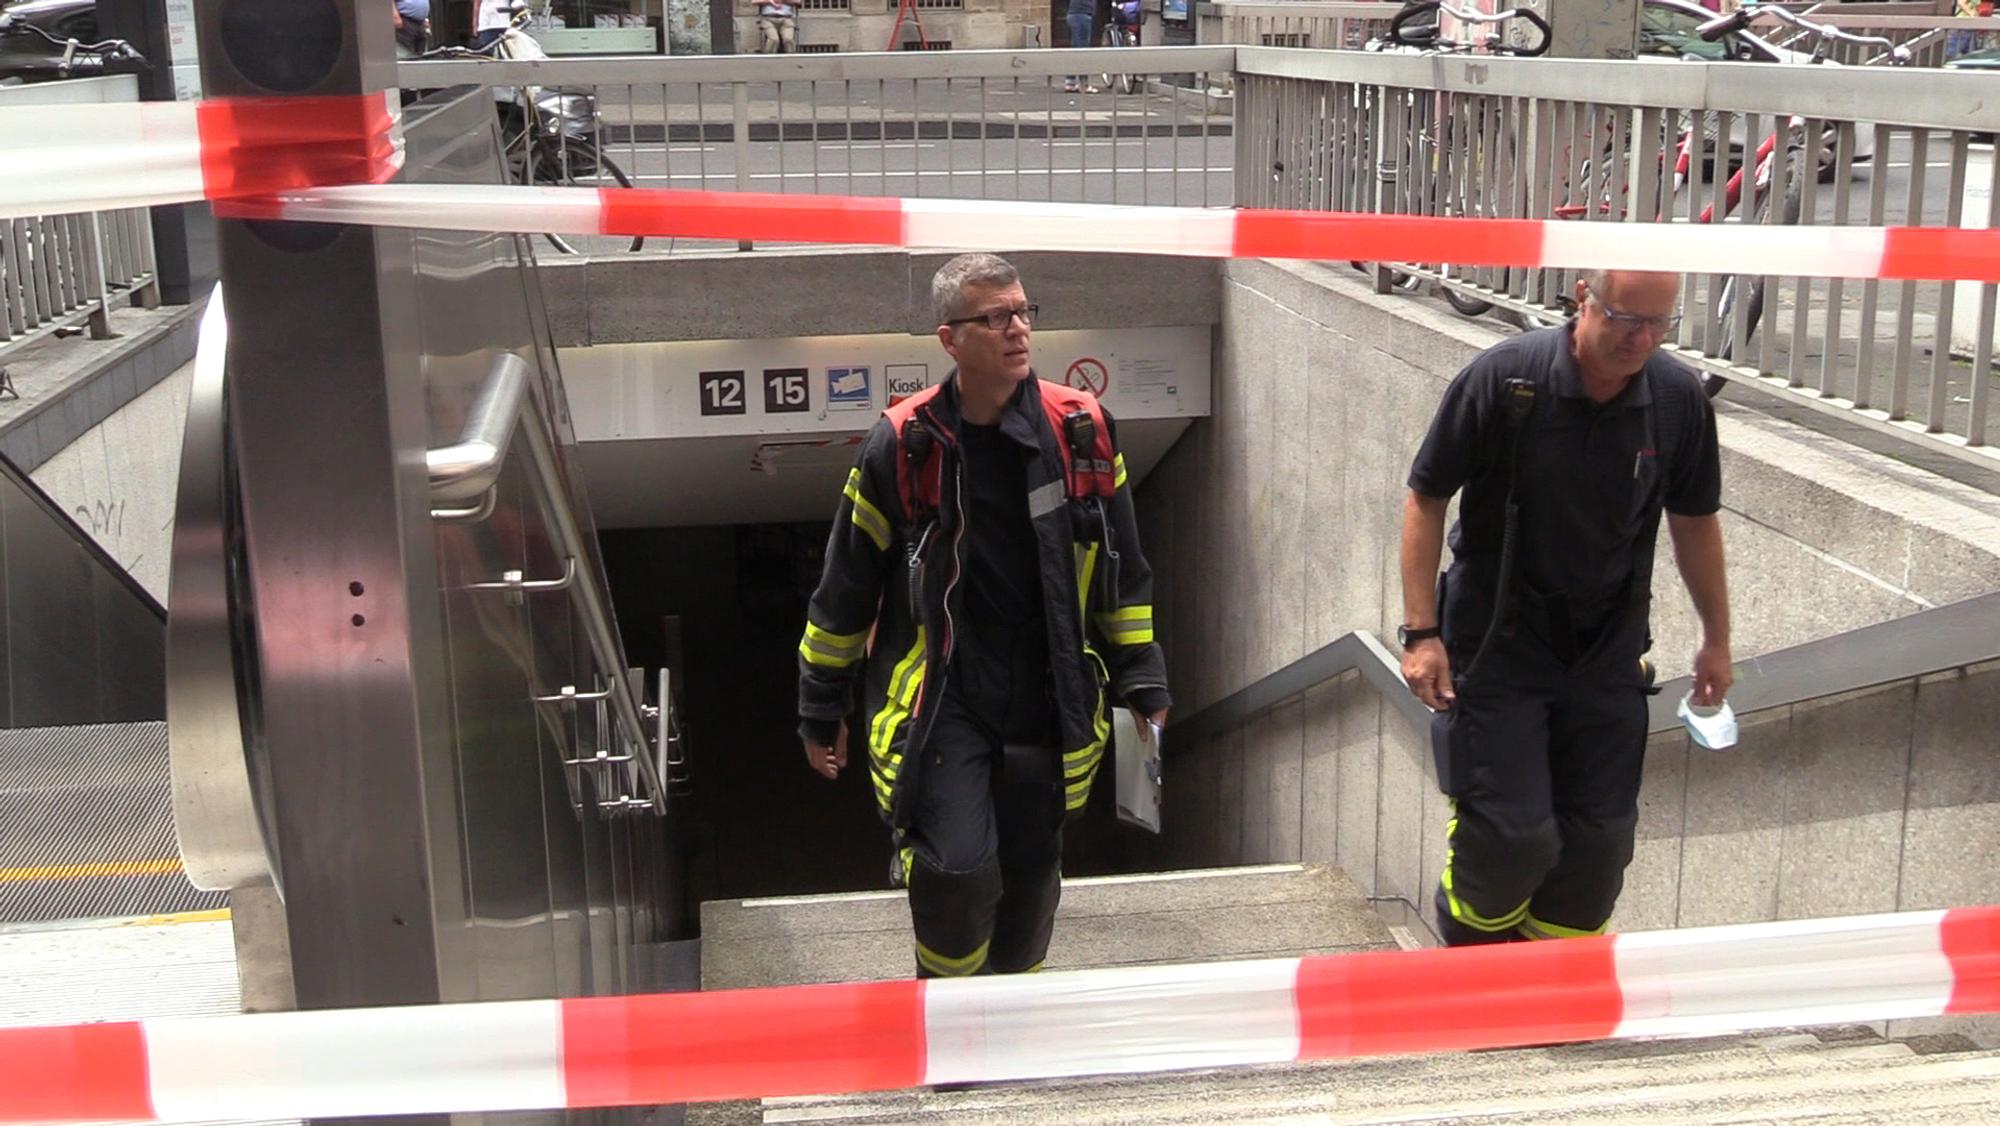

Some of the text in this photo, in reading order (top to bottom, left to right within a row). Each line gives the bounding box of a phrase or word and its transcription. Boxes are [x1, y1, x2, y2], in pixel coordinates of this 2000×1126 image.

[705, 378, 742, 408] 12
[769, 376, 806, 406] 15
[889, 378, 924, 393] Kiosk
